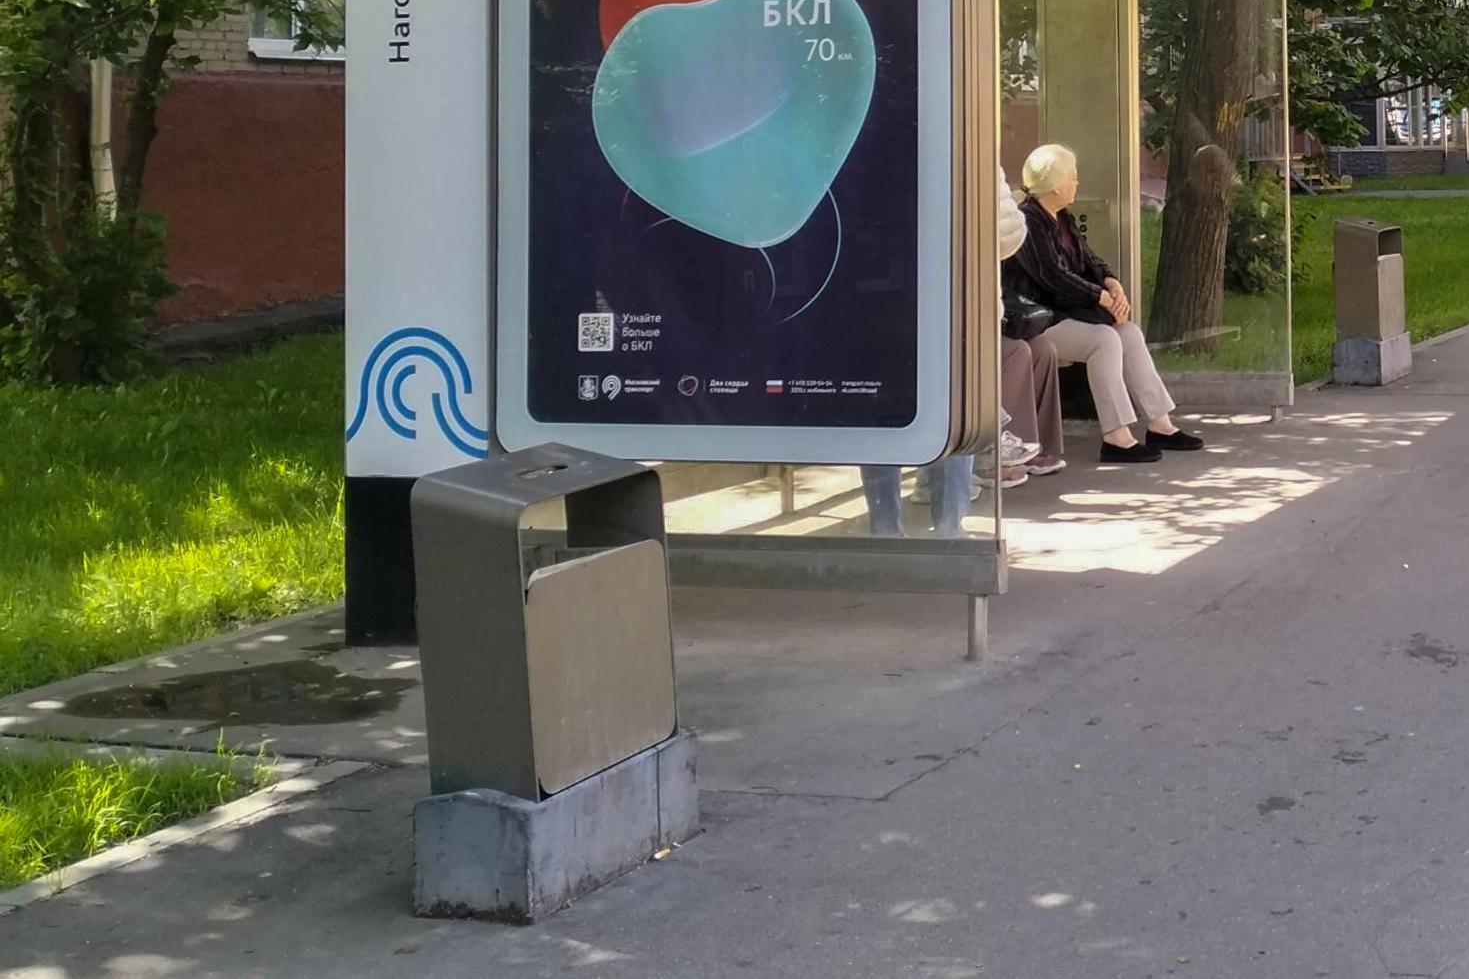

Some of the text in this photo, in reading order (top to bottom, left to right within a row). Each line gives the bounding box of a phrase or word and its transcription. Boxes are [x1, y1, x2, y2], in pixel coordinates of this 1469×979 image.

[804, 38, 835, 62] 70
[621, 312, 662, 324] Узнайте
[621, 340, 653, 352] о БКЛ
